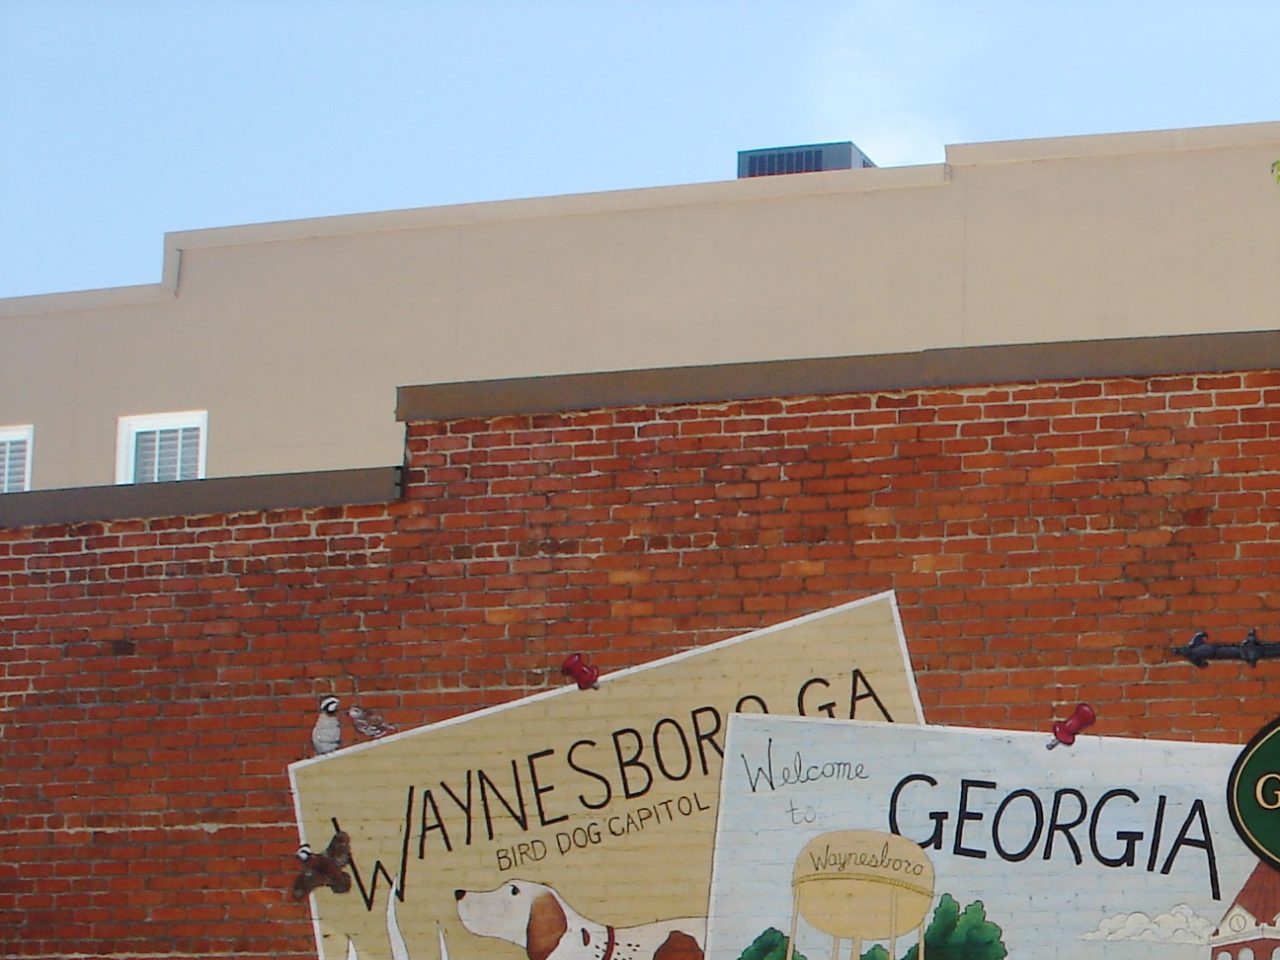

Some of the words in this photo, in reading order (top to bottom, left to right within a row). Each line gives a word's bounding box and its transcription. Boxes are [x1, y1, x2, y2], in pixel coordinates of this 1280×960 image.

[331, 695, 769, 911] WAYNESBOR
[796, 668, 894, 723] GA
[740, 737, 870, 793] Welcome
[496, 839, 547, 872] BIRD
[556, 822, 601, 856] DOG
[608, 792, 710, 837] CAPITOL
[809, 841, 925, 876] Waynesboro
[888, 773, 1221, 901] GEORGIA
